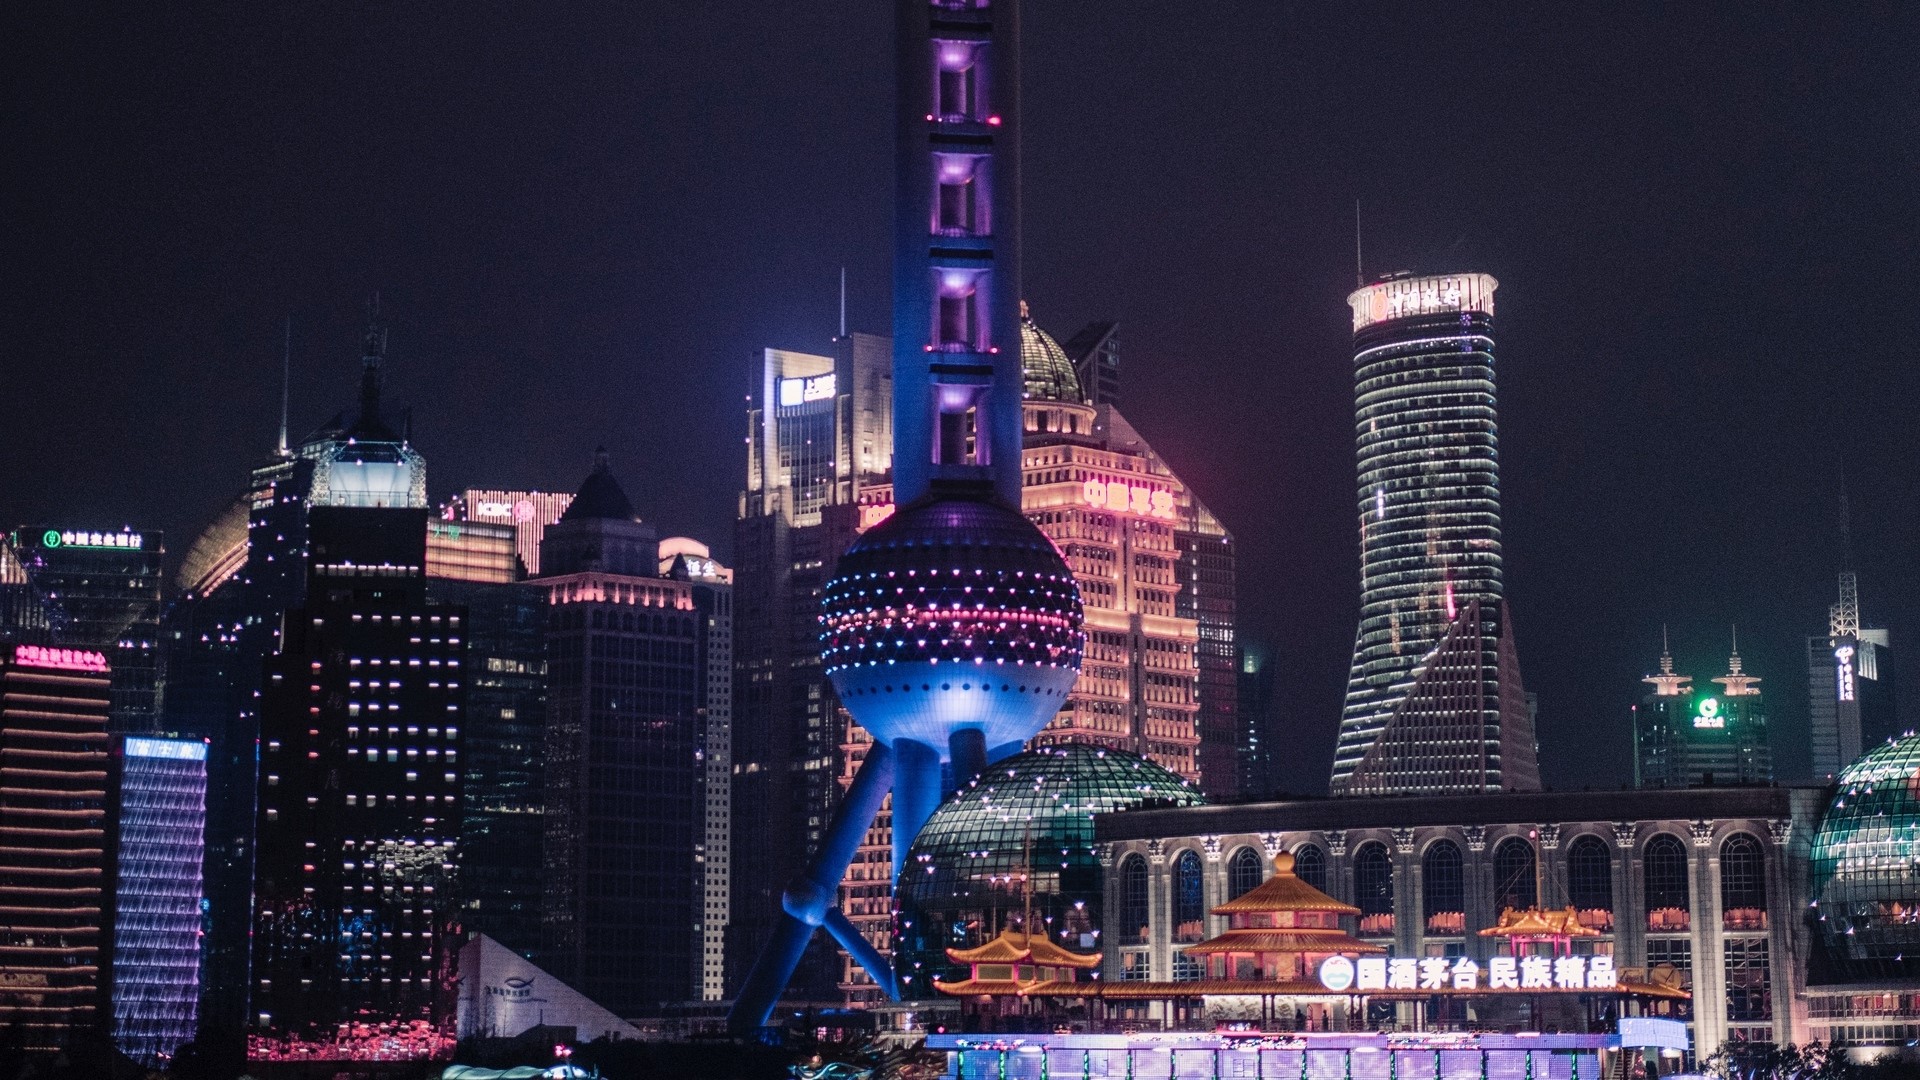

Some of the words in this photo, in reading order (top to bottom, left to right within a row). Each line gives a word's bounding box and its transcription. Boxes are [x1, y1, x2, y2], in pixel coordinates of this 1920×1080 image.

[1084, 479, 1173, 519] 中国平安
[478, 501, 512, 517] ICBC
[62, 531, 141, 547] 中国农业银行
[686, 559, 716, 577] 恒生
[16, 645, 106, 665] 中国金融信息中心
[1357, 957, 1479, 989] 国酒茅台
[1489, 957, 1617, 988] 民族精品
